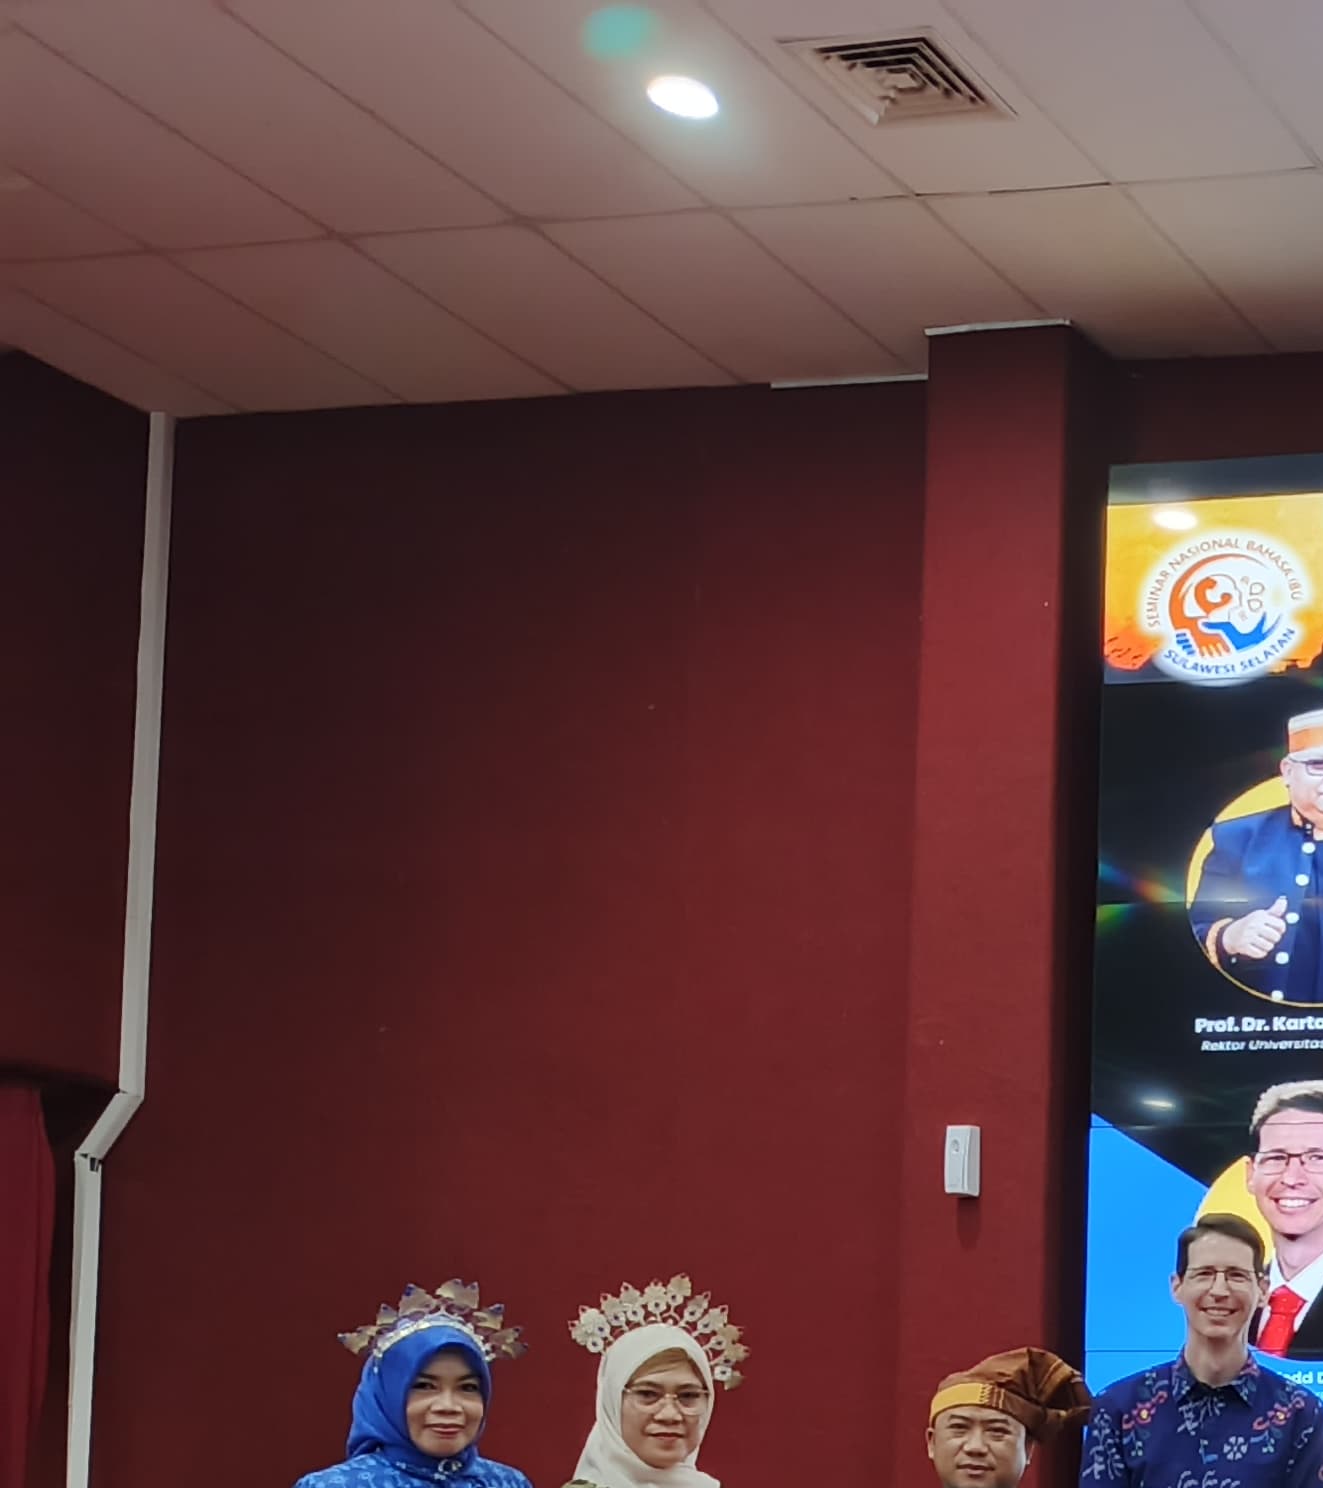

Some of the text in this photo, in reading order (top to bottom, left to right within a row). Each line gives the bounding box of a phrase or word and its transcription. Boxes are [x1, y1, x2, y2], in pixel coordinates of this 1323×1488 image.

[1144, 537, 1304, 628] SEMINAR NASIONAL BAHASA IBU
[1163, 626, 1297, 674] SULAWESI SELATAN
[1194, 1017, 1240, 1033] Prof.
[1241, 1016, 1270, 1032] Dr.
[1201, 1040, 1246, 1051] Rektor
